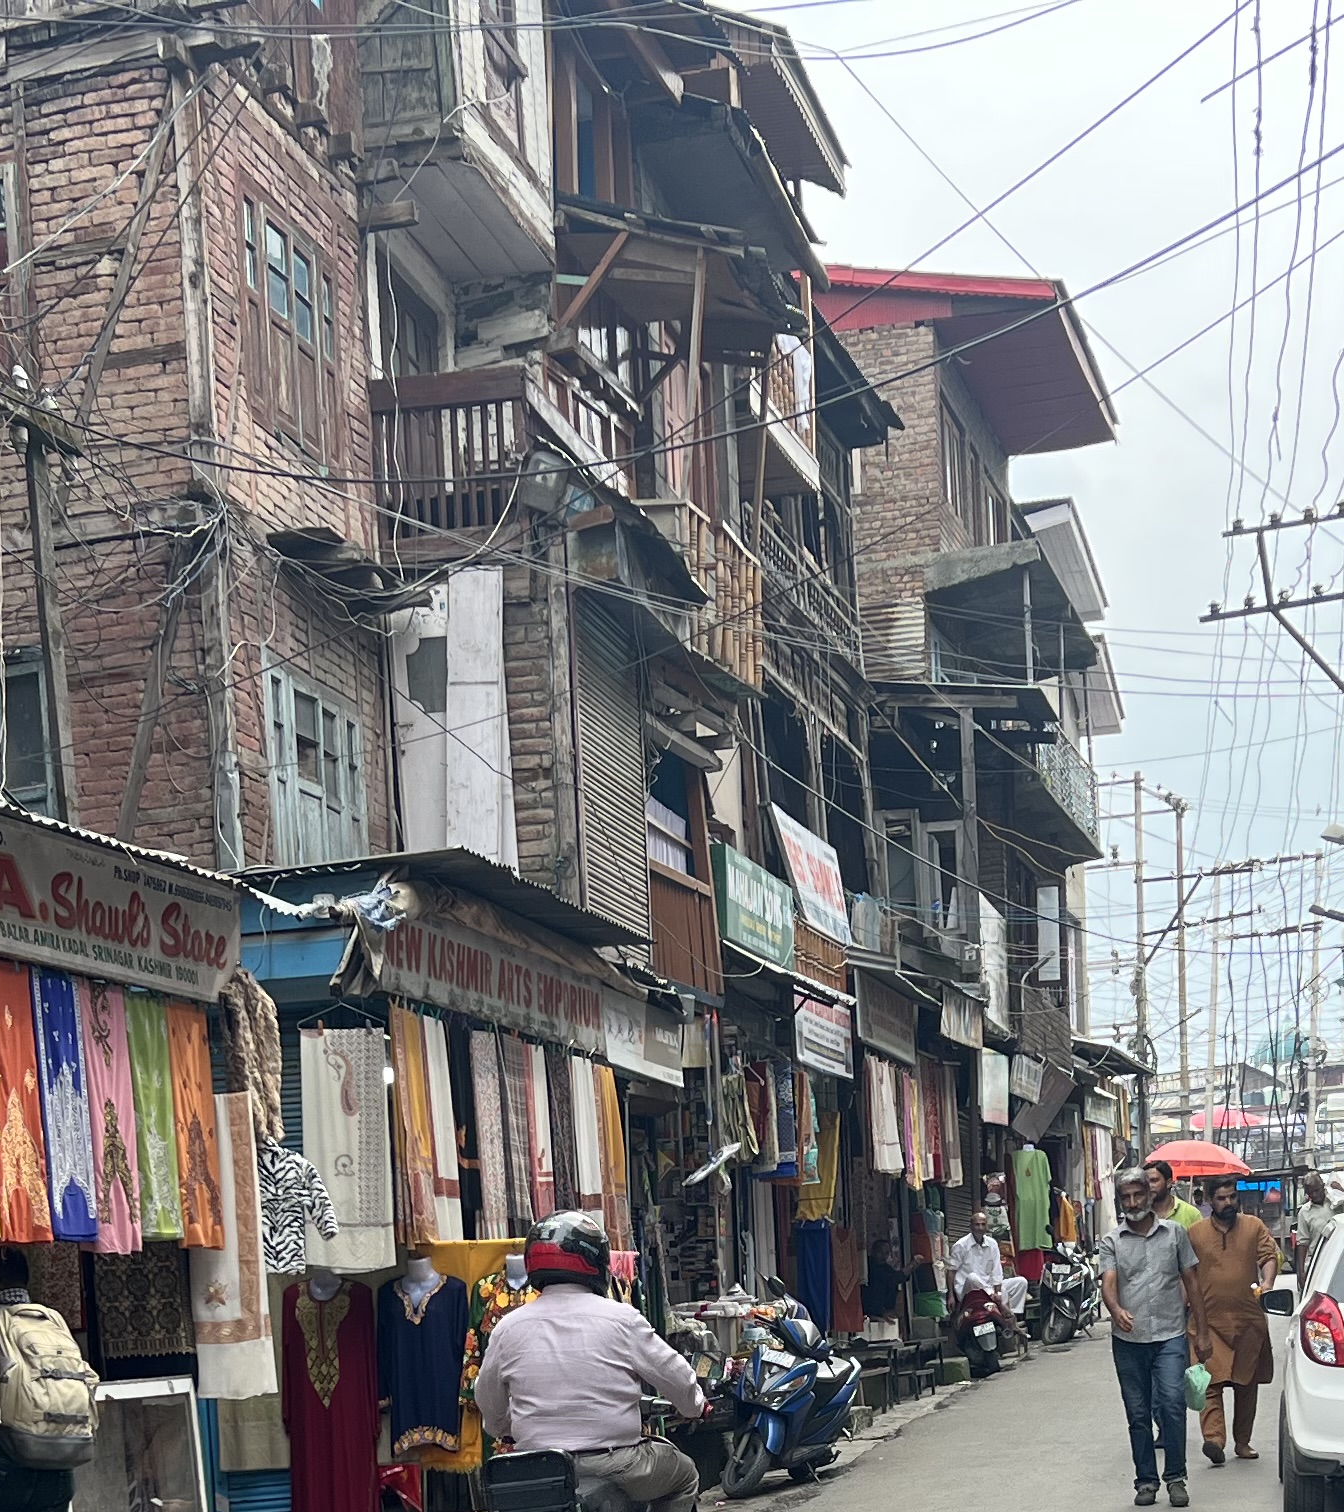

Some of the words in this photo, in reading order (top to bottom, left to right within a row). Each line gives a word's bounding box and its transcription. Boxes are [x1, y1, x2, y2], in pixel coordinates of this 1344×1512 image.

[136, 956, 173, 979] KASHMIR
[159, 901, 229, 970] Store
[385, 920, 424, 975] NEW
[427, 927, 494, 996] KASHMIR
[497, 957, 533, 1009] ARTS
[536, 970, 602, 1031] EMPORIUM
